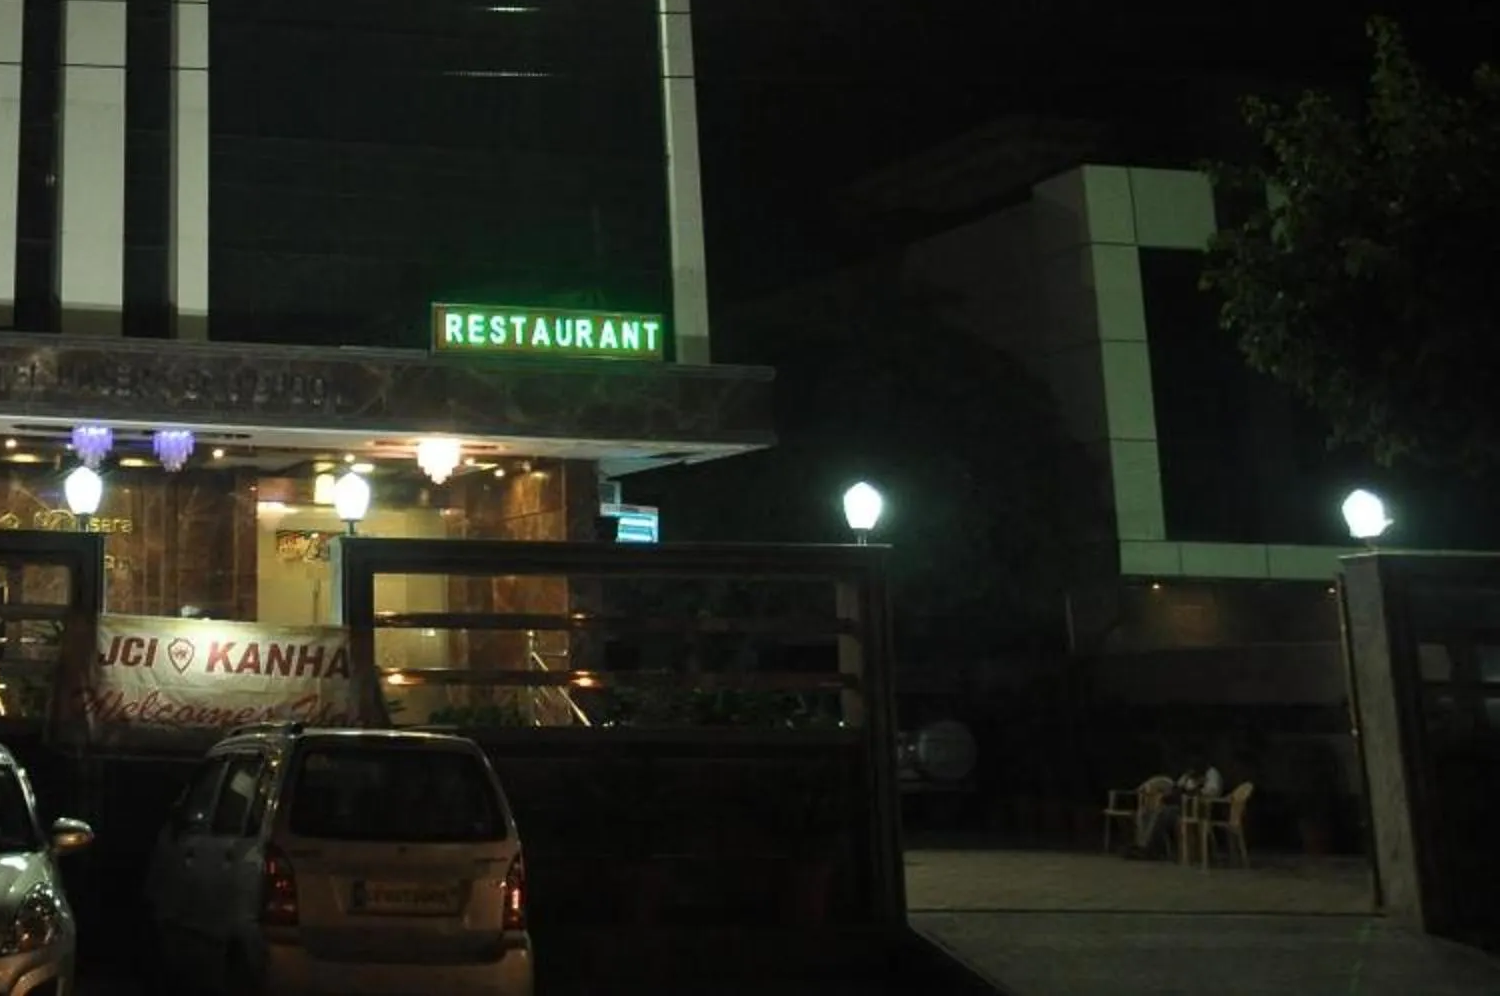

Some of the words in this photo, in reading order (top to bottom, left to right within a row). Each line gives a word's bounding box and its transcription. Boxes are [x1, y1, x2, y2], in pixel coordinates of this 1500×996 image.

[444, 313, 659, 351] RESTAURANT
[100, 635, 158, 668] JCI
[206, 641, 350, 679] KANHA
